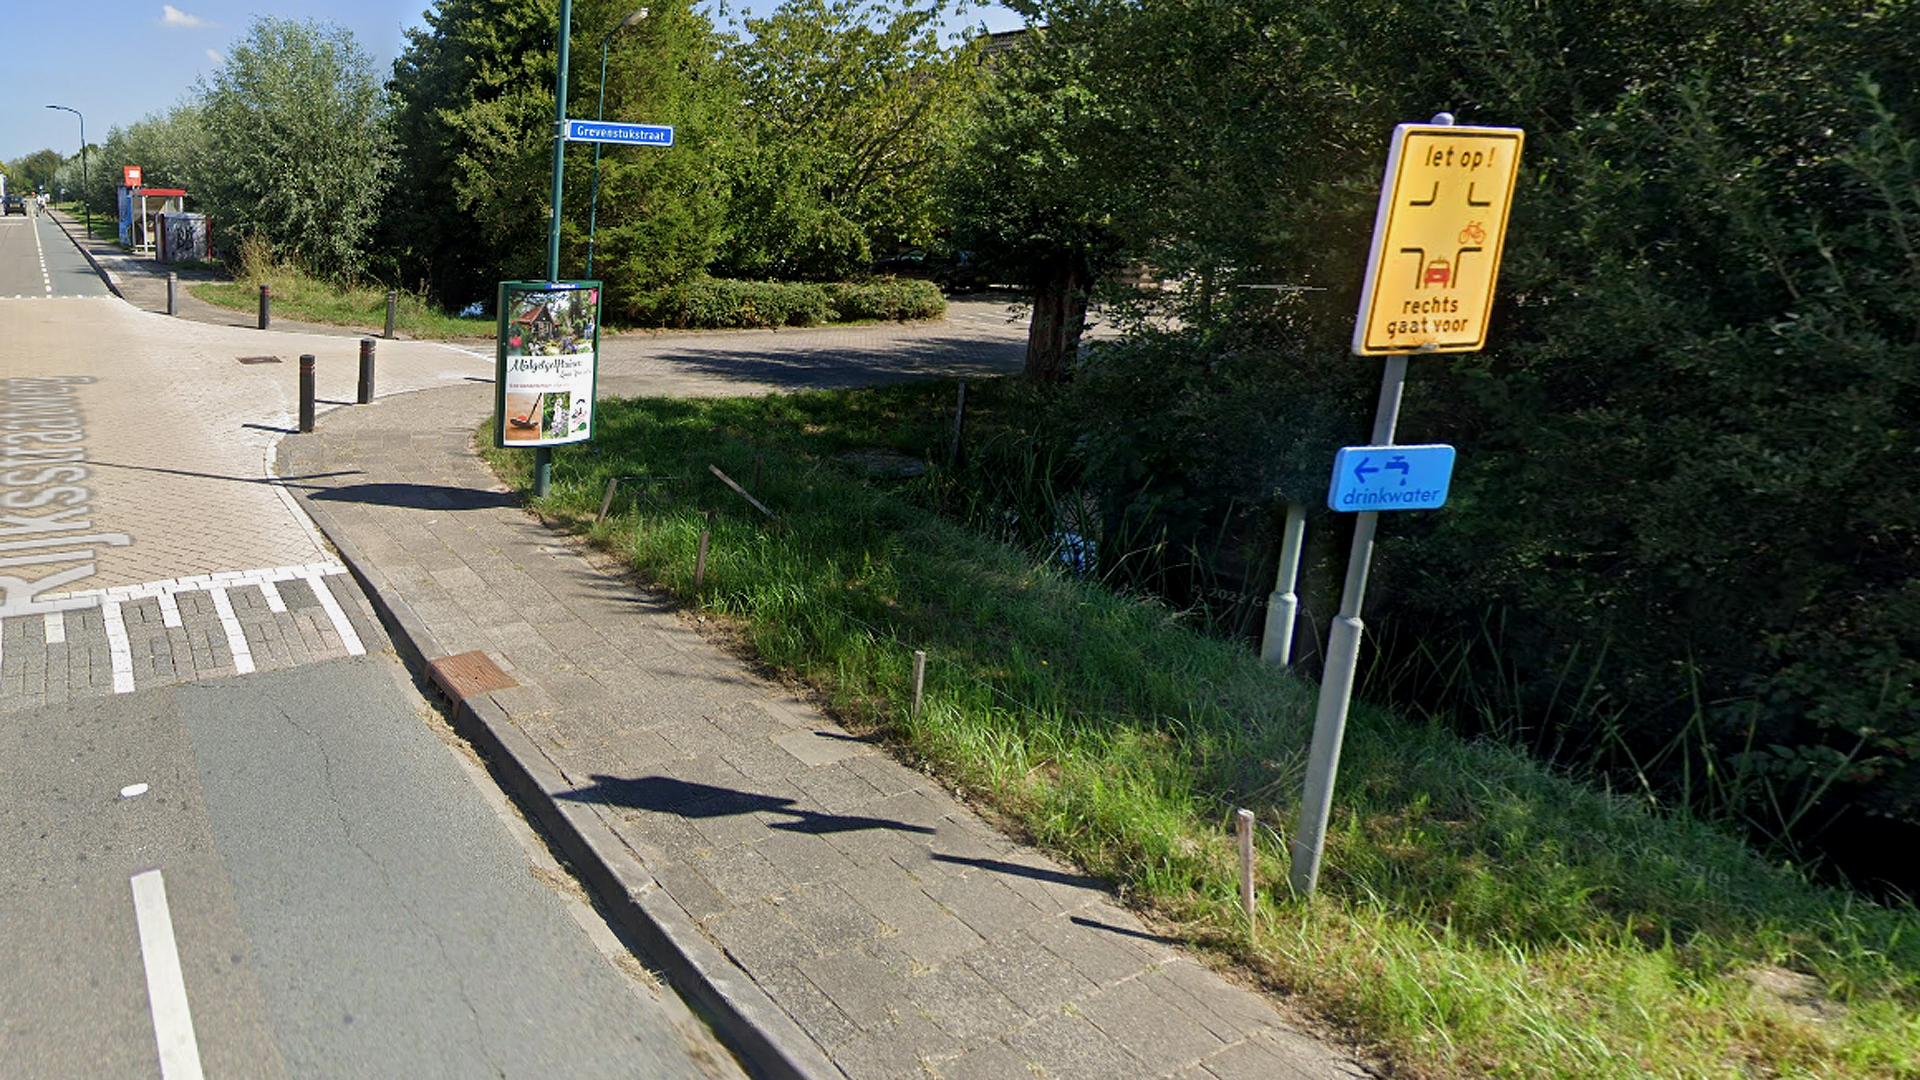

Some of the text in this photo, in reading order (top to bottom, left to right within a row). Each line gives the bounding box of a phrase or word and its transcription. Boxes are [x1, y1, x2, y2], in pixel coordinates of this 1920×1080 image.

[577, 126, 665, 141] Grevenstukstraat
[1425, 145, 1454, 167] let
[1402, 296, 1459, 315] rechts
[1386, 317, 1469, 340] gaat voor
[1342, 486, 1440, 505] drinkwater
